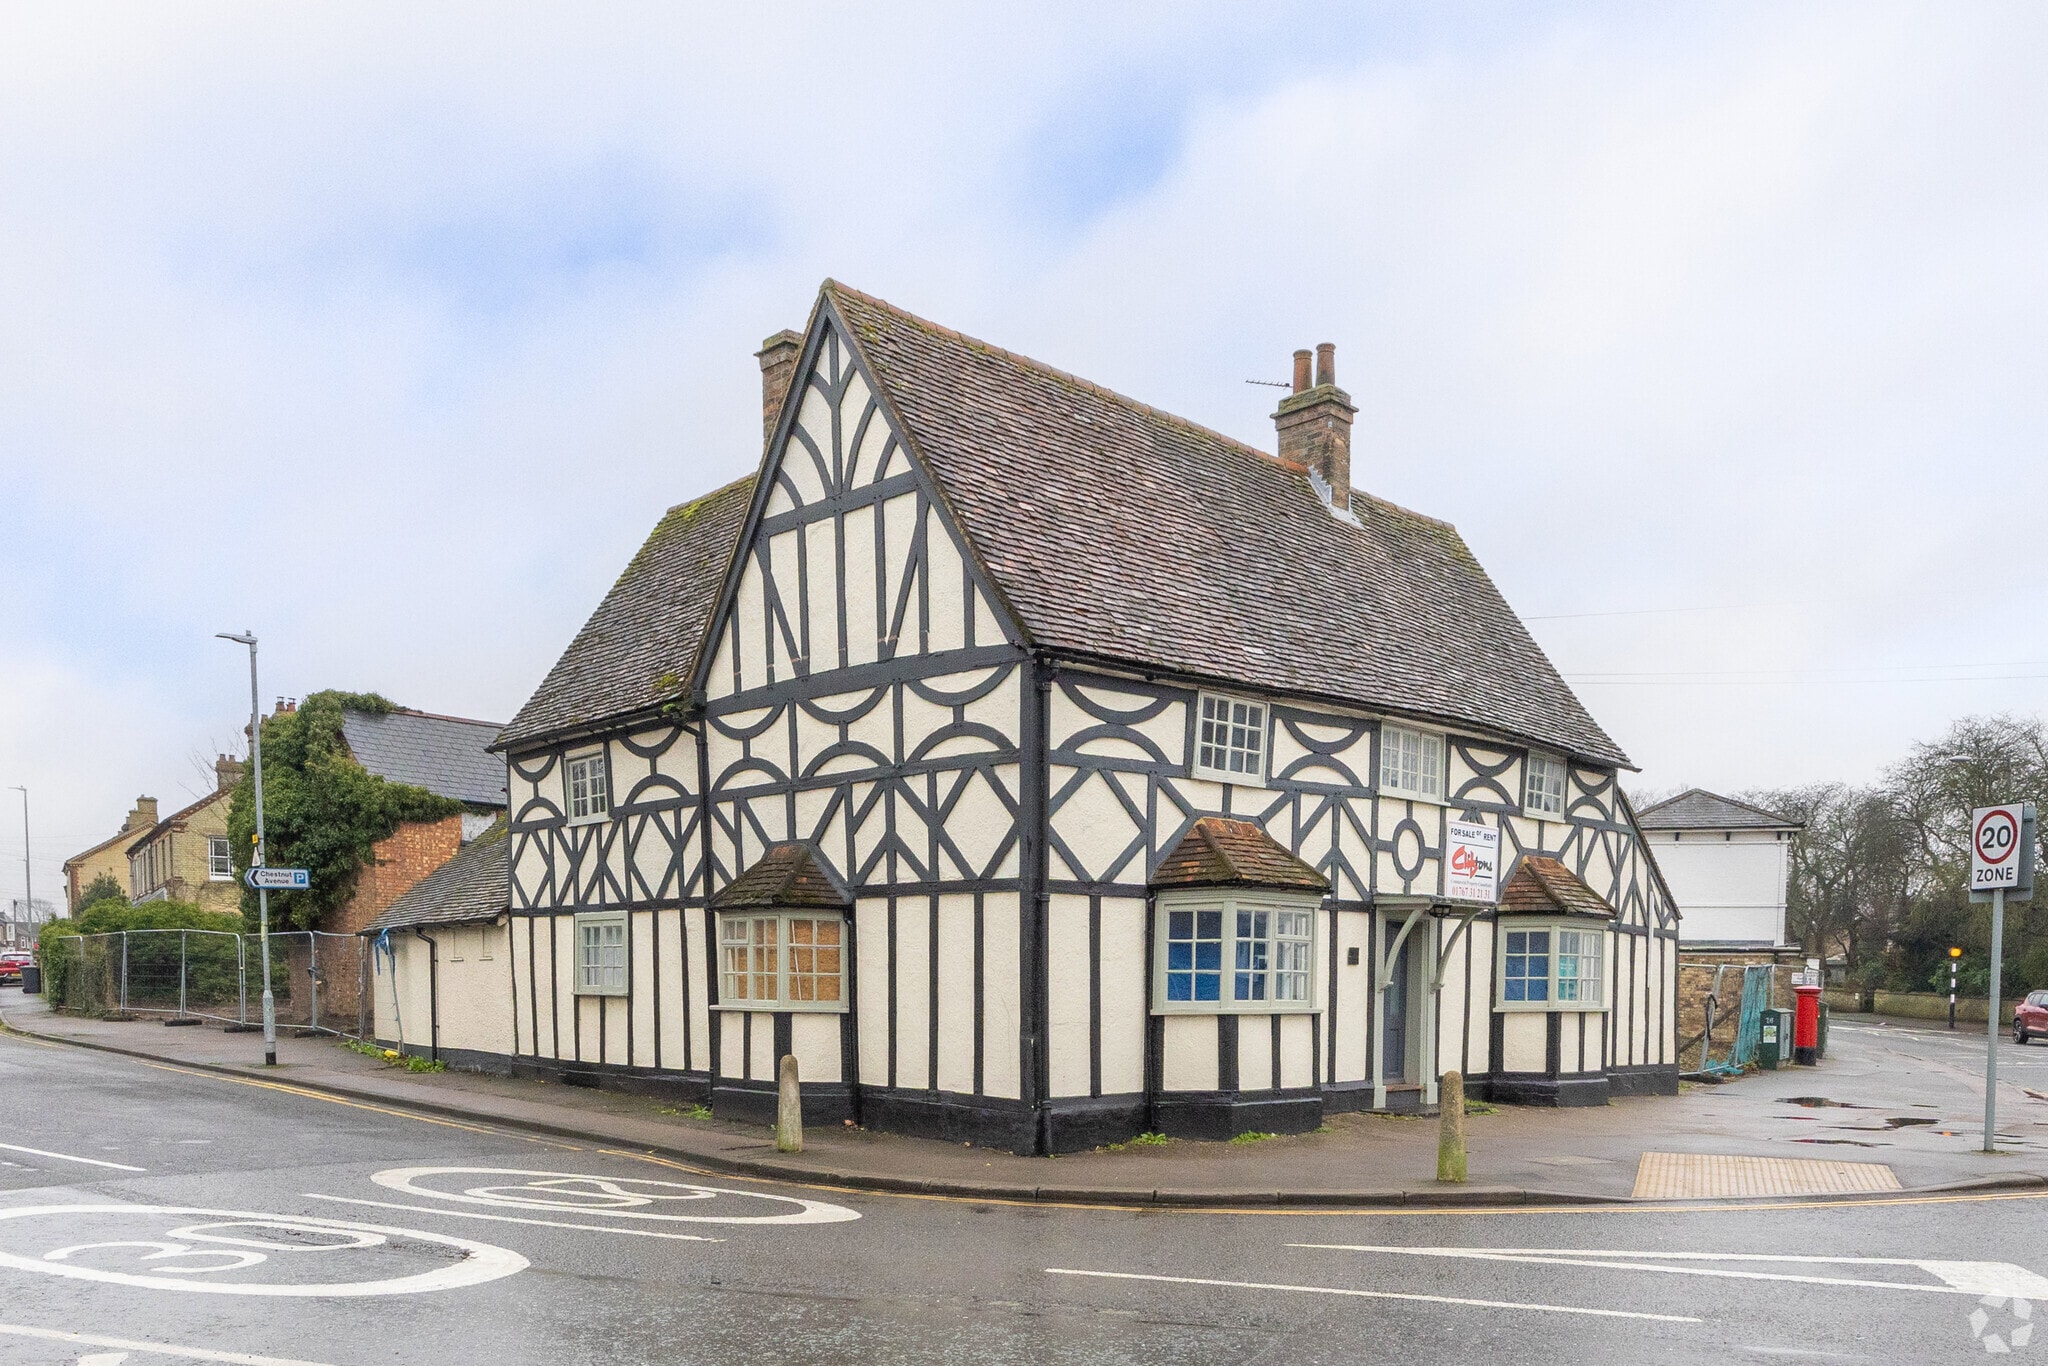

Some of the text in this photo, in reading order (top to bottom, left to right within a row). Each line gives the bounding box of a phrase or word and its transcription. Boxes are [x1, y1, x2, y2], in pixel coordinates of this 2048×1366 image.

[1451, 828, 1462, 836] FOR
[1462, 830, 1475, 838] SALE
[1483, 833, 1496, 841] RENT
[1982, 825, 2011, 849] 20
[1976, 867, 2013, 882] ZONE
[1451, 886, 1468, 896] 01767
[43, 1221, 386, 1273] 30
